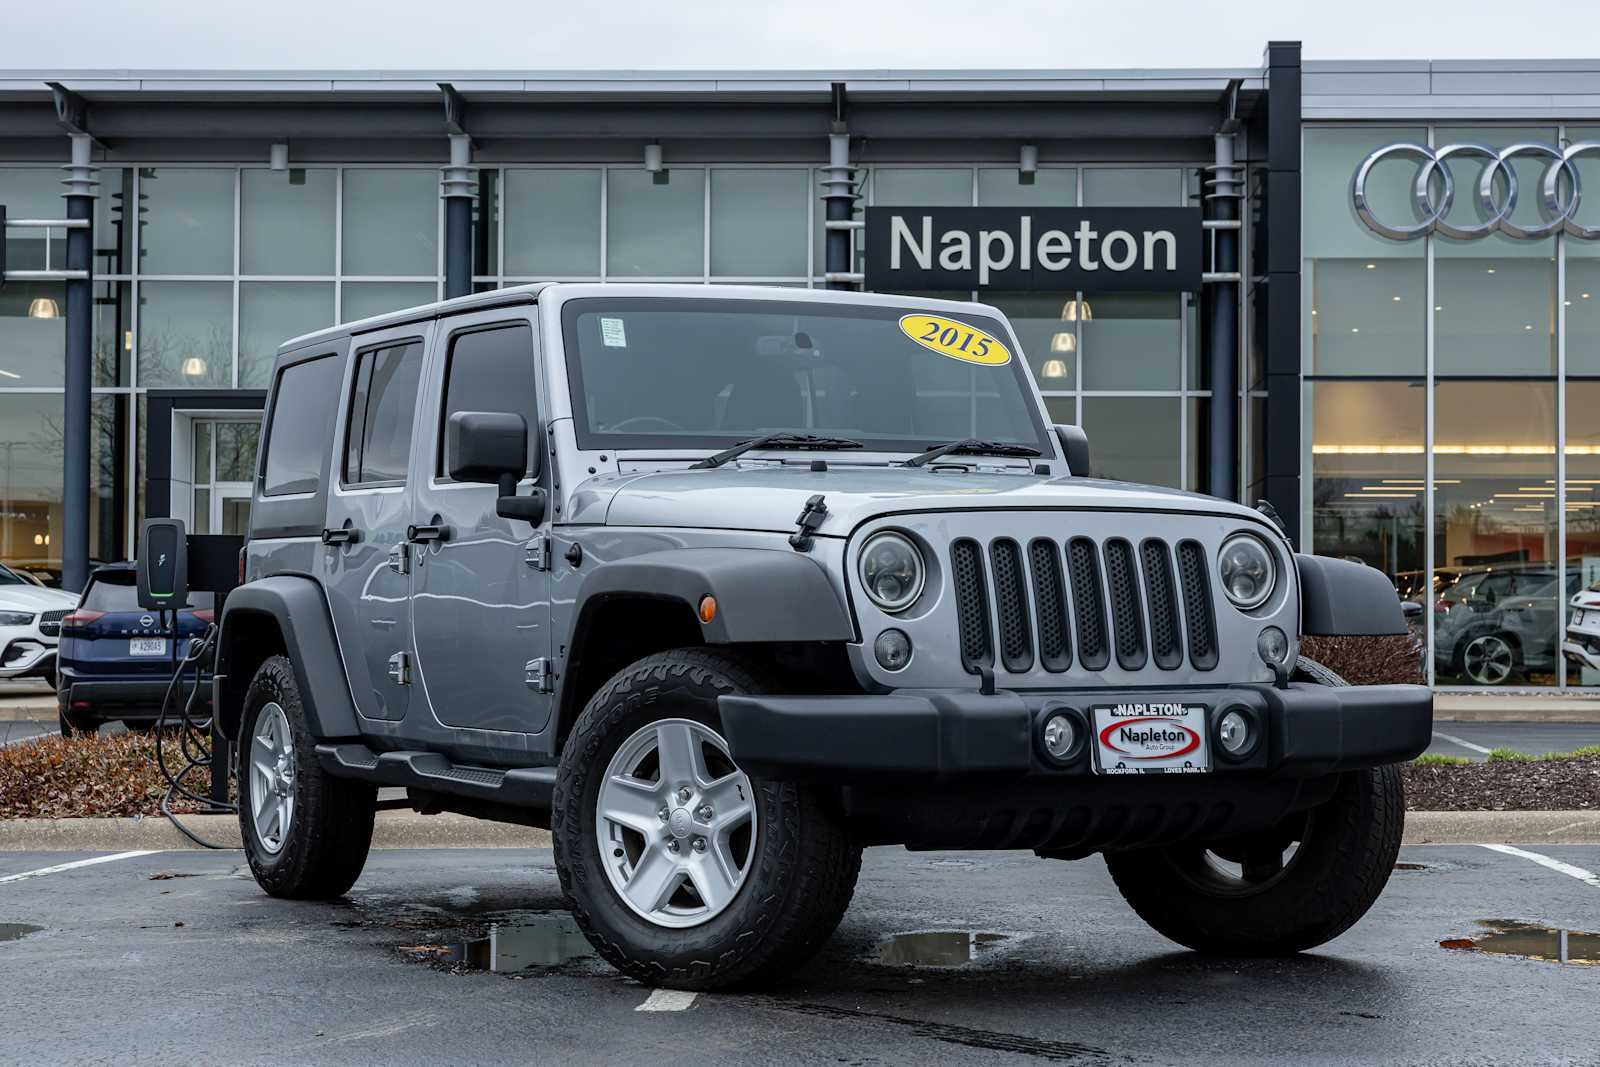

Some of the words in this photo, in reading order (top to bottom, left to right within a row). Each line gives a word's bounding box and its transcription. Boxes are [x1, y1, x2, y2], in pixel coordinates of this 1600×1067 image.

[890, 215, 1177, 285] Napleton
[919, 322, 993, 357] 2015
[1117, 704, 1182, 716] NAPLETON
[1120, 728, 1185, 744] Napleton
